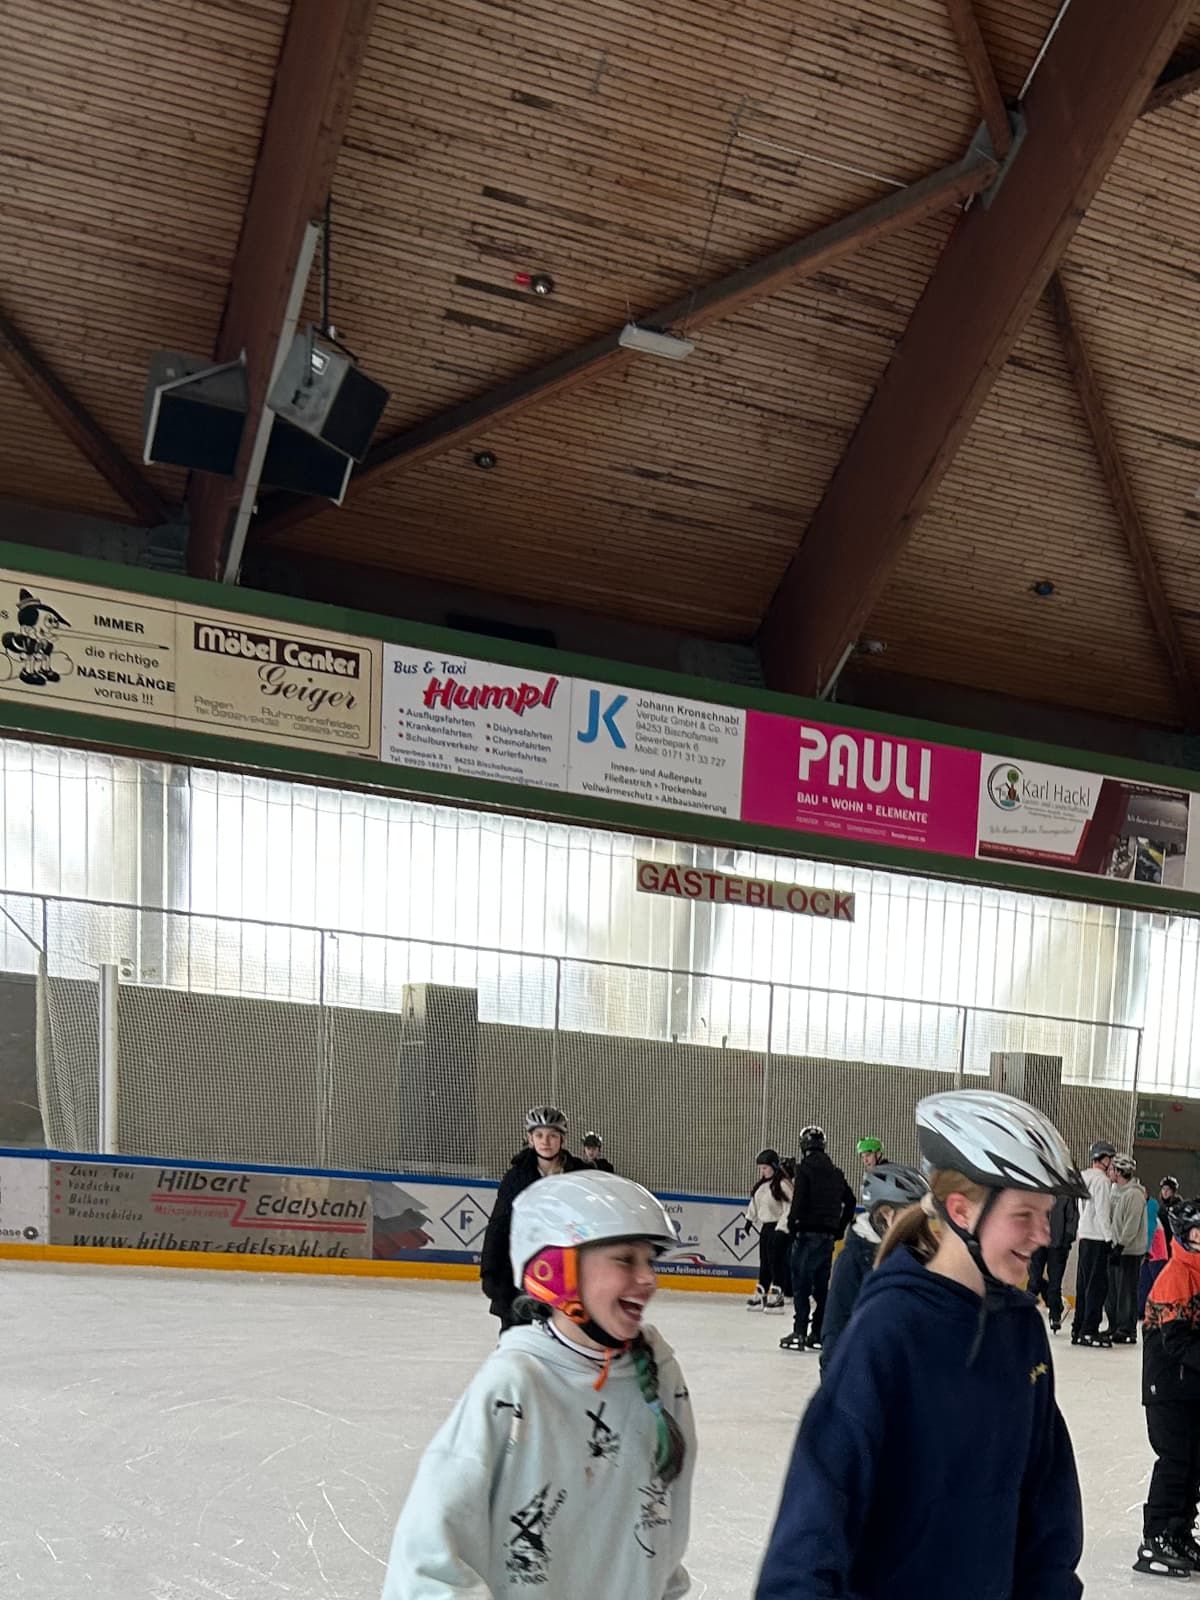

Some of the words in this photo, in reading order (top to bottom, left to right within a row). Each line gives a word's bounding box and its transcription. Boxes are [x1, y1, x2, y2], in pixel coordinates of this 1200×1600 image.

[93, 614, 145, 635] IMMER
[85, 645, 106, 658] die
[109, 650, 160, 669] richtige
[198, 625, 278, 662] Möbel
[283, 642, 357, 677] Center
[77, 664, 177, 693] NASENLÄNGE
[393, 660, 418, 675] Bus
[423, 660, 435, 675] &
[440, 660, 468, 675] Taxi
[94, 687, 139, 703] voraus
[257, 663, 358, 713] Geiger
[423, 676, 559, 718] Humpl
[406, 707, 476, 728] Ausflugsfahrten
[577, 689, 629, 750] JK
[636, 698, 675, 714] Johann
[677, 706, 740, 726] Kronschnabl
[636, 710, 668, 725] Verputz
[670, 716, 698, 730] GmbH
[724, 727, 739, 737] KG
[405, 720, 473, 739] Krankenfahrten
[405, 732, 480, 752] Schulbusverkehr
[493, 722, 553, 742] Dialysefahrten
[635, 733, 692, 751] Gewerbepark
[492, 747, 548, 764] Kurierfahrten
[661, 749, 683, 761] 0171
[711, 756, 727, 768] 727
[798, 725, 932, 802] PAULI
[604, 773, 653, 789] Fließestrich
[660, 782, 708, 798] Trockenbau
[610, 762, 638, 775] Innen-
[639, 766, 656, 778] und
[657, 770, 703, 786] Außenputz
[582, 782, 653, 802] Vollwärmeschutz
[1022, 778, 1050, 801] Karl
[1053, 782, 1091, 808] Hackl
[797, 791, 819, 805] BAU
[831, 797, 864, 813] WOHN
[875, 805, 929, 824] ELEMENTE
[638, 863, 855, 921] GÄSTEBLOCK
[157, 1169, 251, 1194] Hilbert
[255, 1194, 367, 1219] Edelstahl
